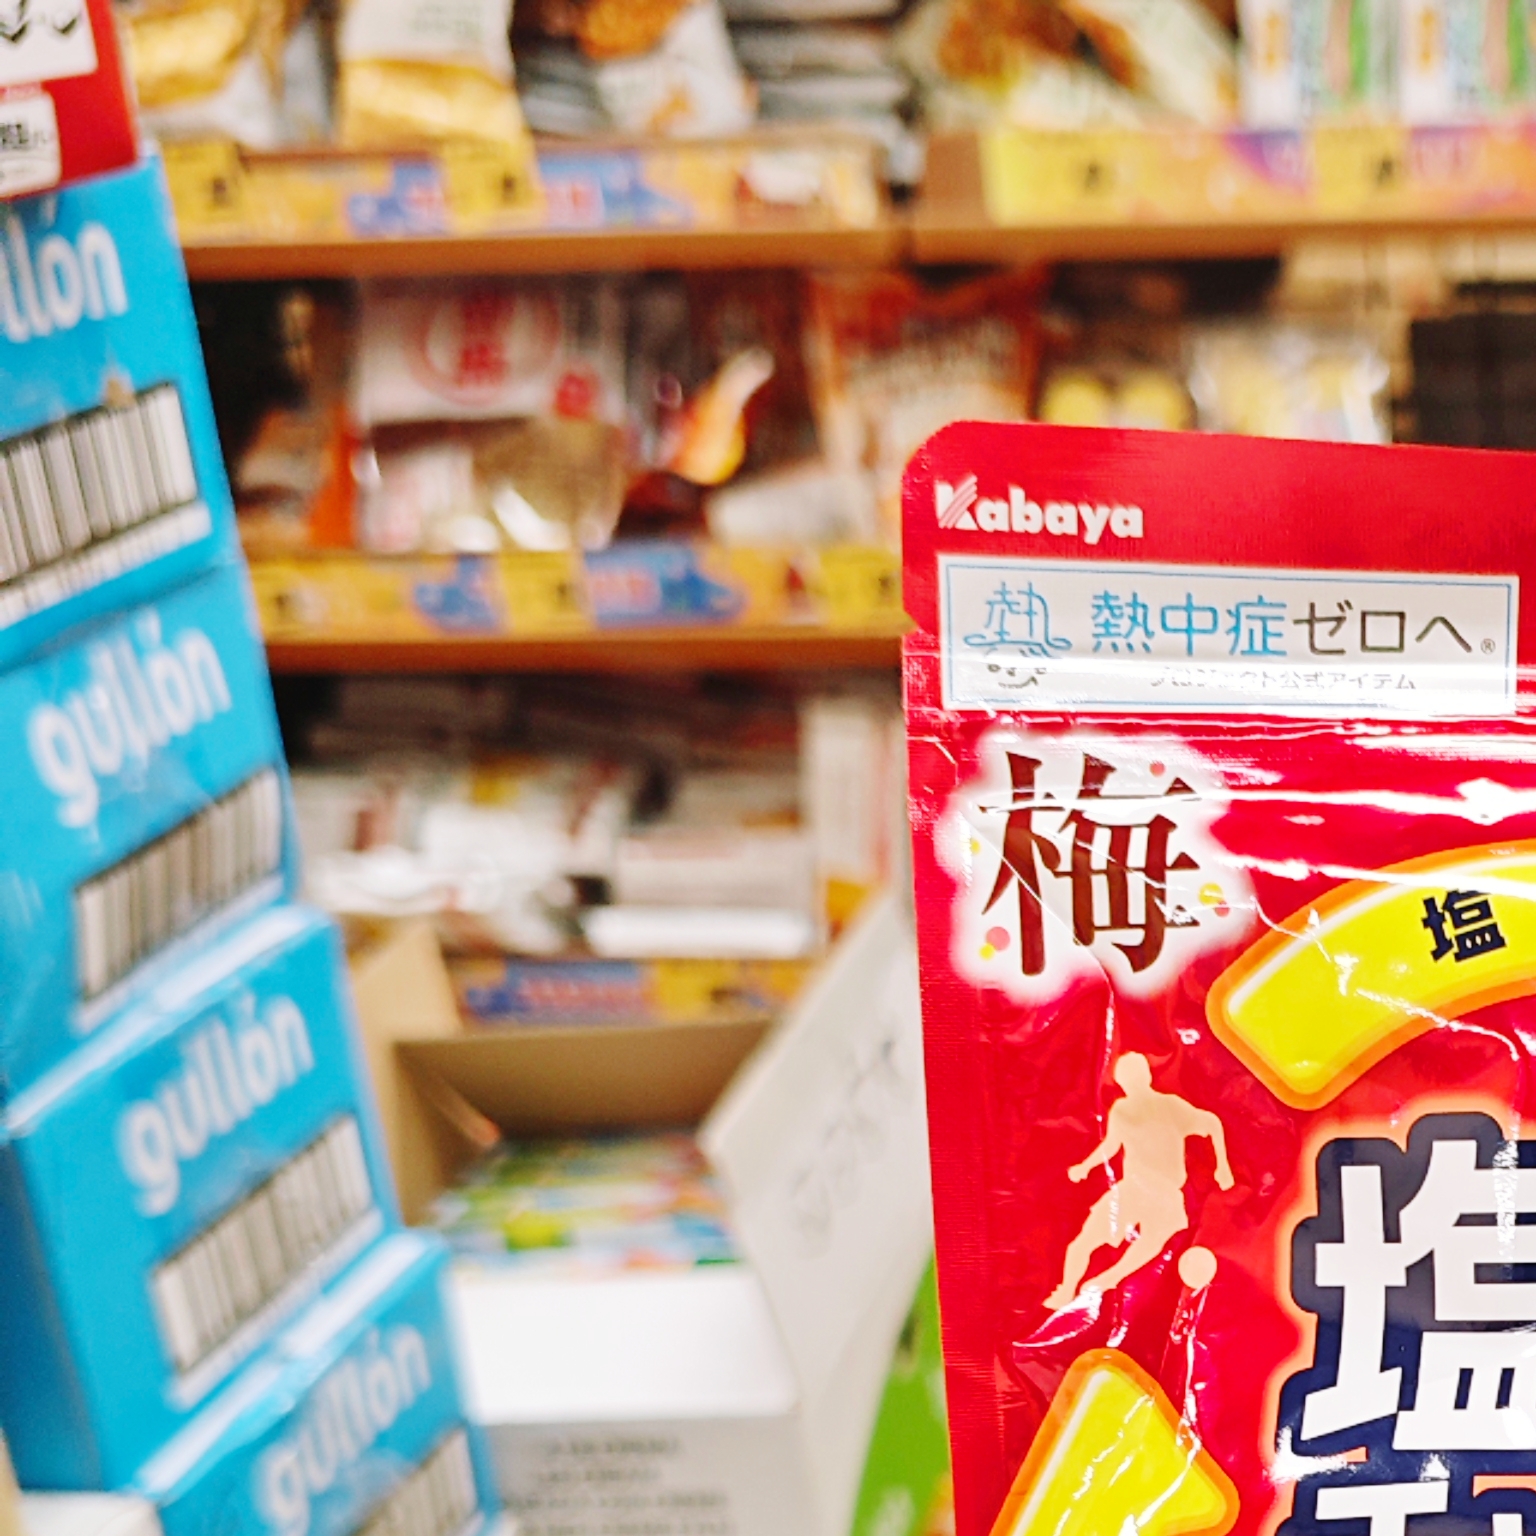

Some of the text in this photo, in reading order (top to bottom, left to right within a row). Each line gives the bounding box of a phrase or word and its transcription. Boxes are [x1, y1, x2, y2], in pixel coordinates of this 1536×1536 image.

[936, 475, 1143, 544] Kabaya
[28, 608, 232, 829] gullón
[977, 751, 1202, 976] 梅
[118, 990, 315, 1218] gullón
